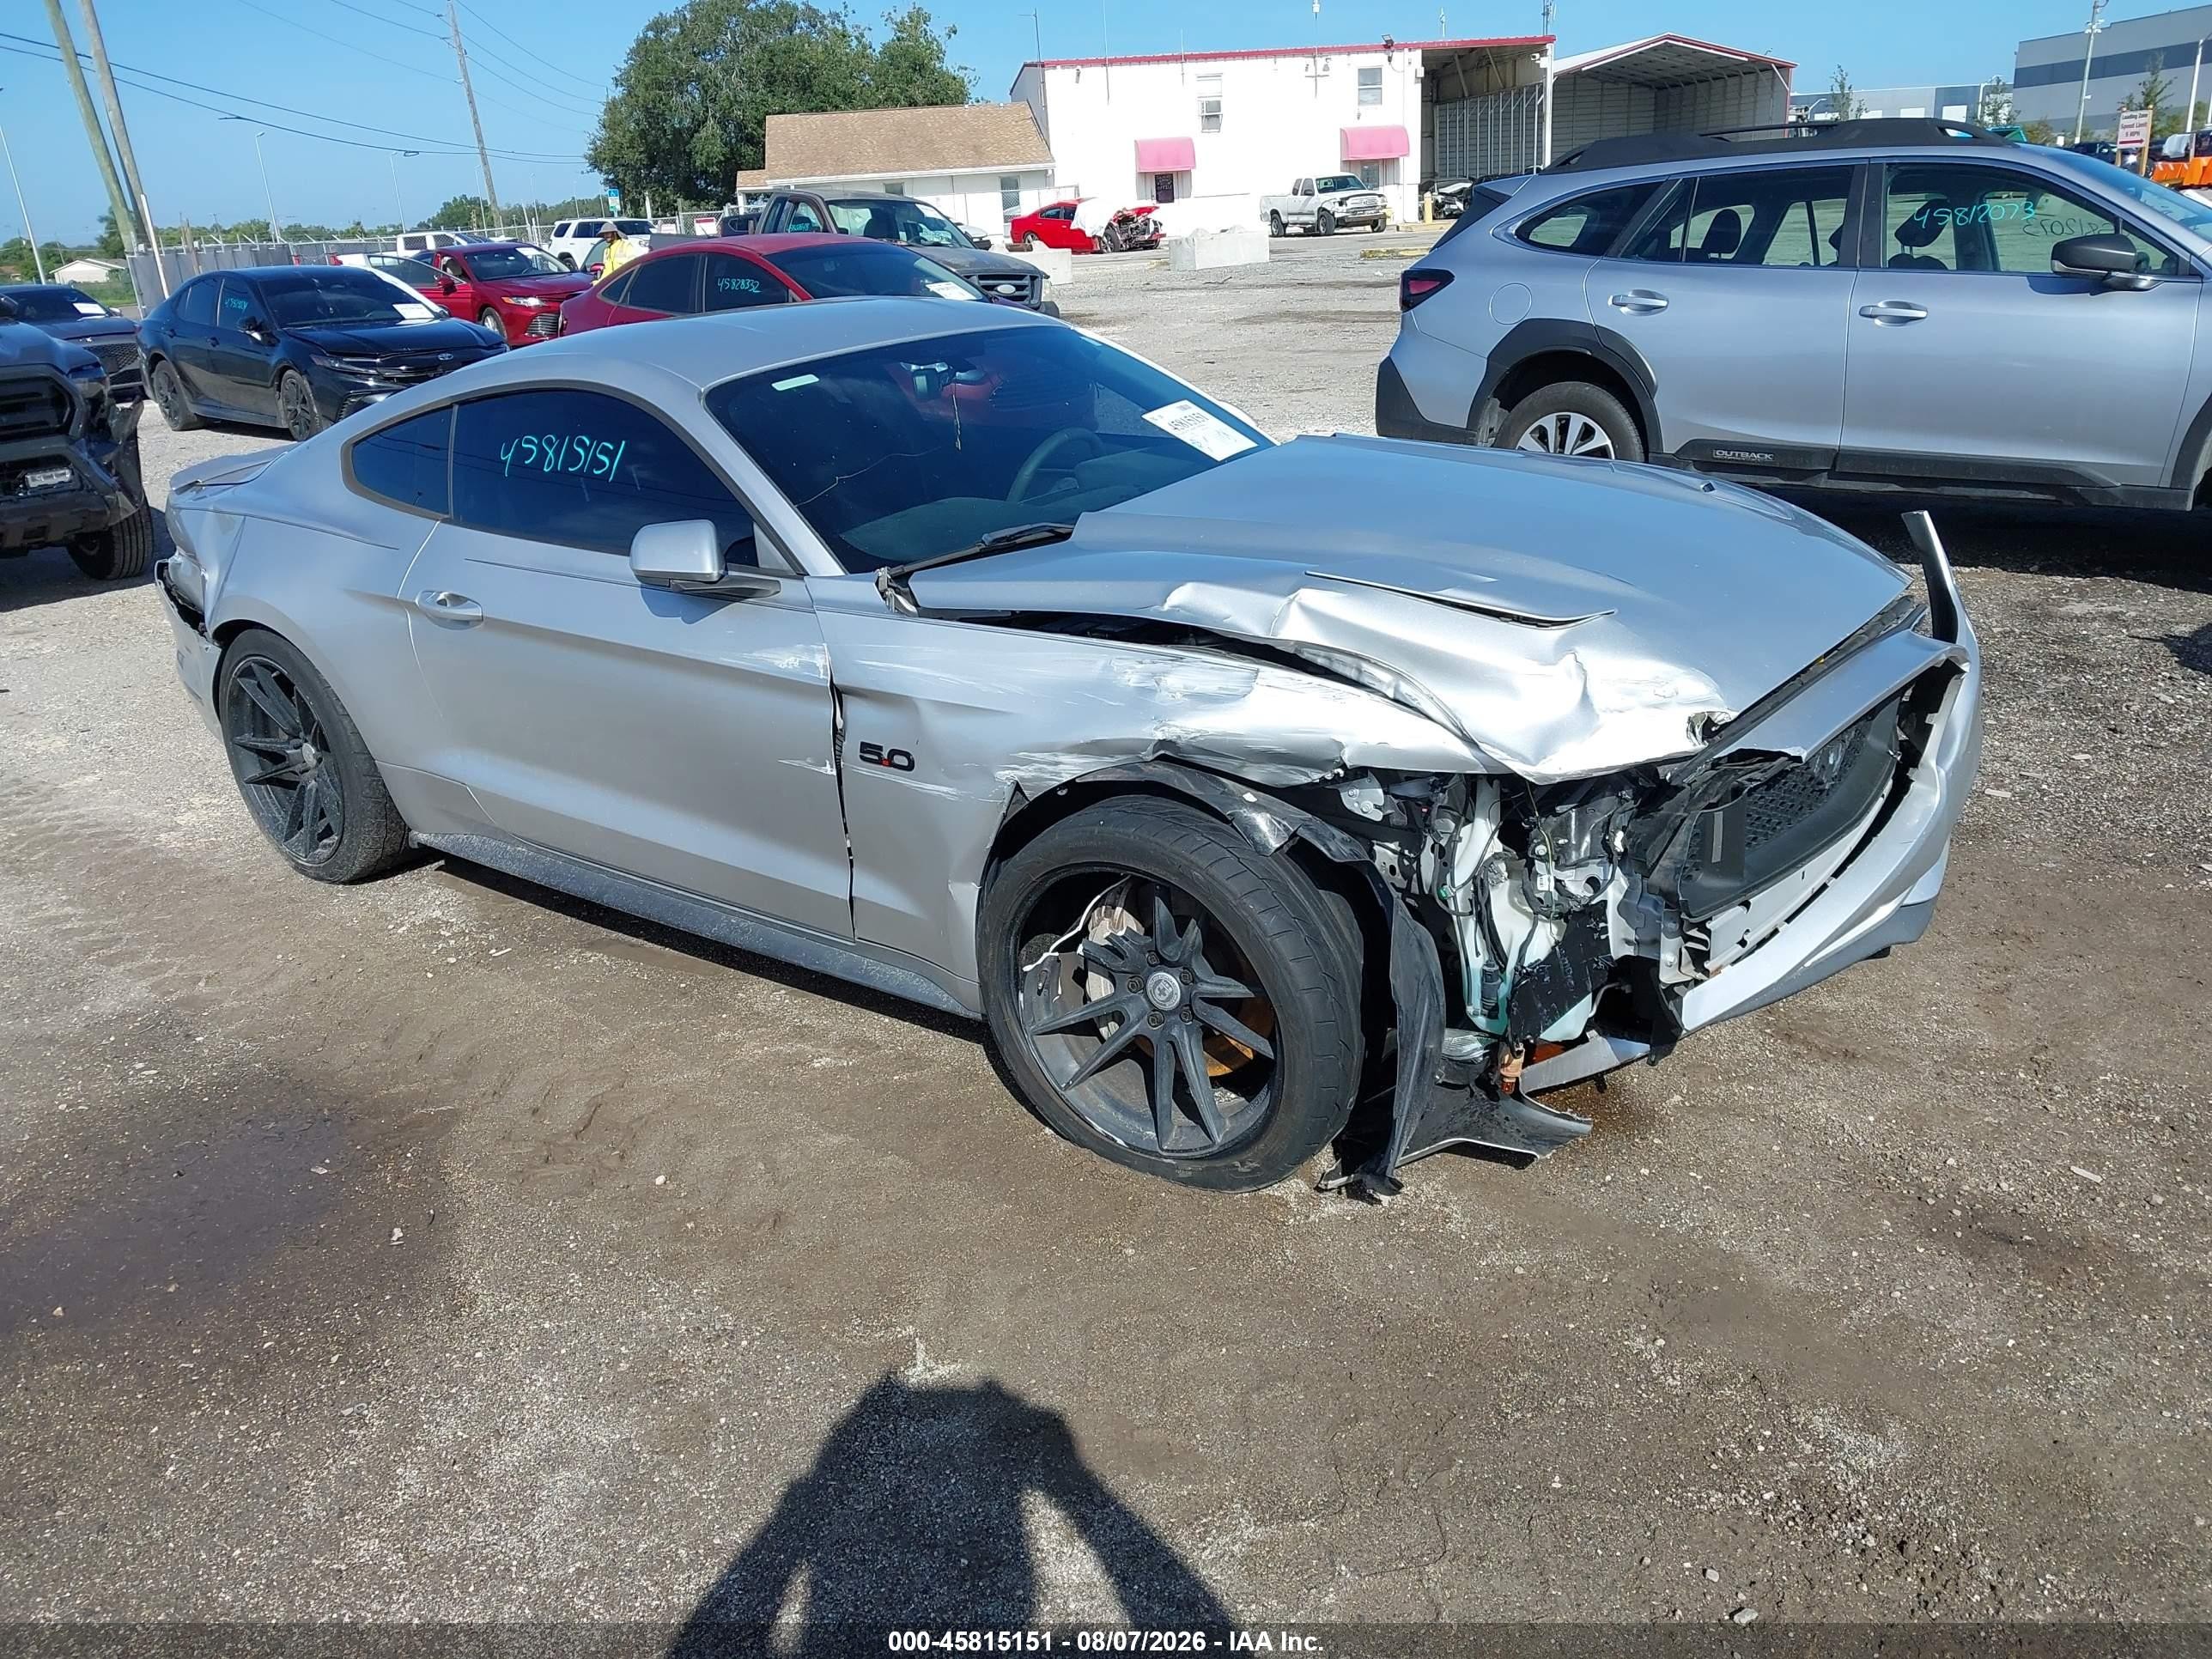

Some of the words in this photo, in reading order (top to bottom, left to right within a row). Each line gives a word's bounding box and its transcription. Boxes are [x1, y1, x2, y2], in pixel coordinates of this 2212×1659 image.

[1913, 201, 2036, 229] 45812073
[717, 277, 763, 293] 45828332
[500, 434, 626, 483] 45815151
[1716, 449, 1774, 460] OUTBACK
[859, 741, 915, 772] 5.0
